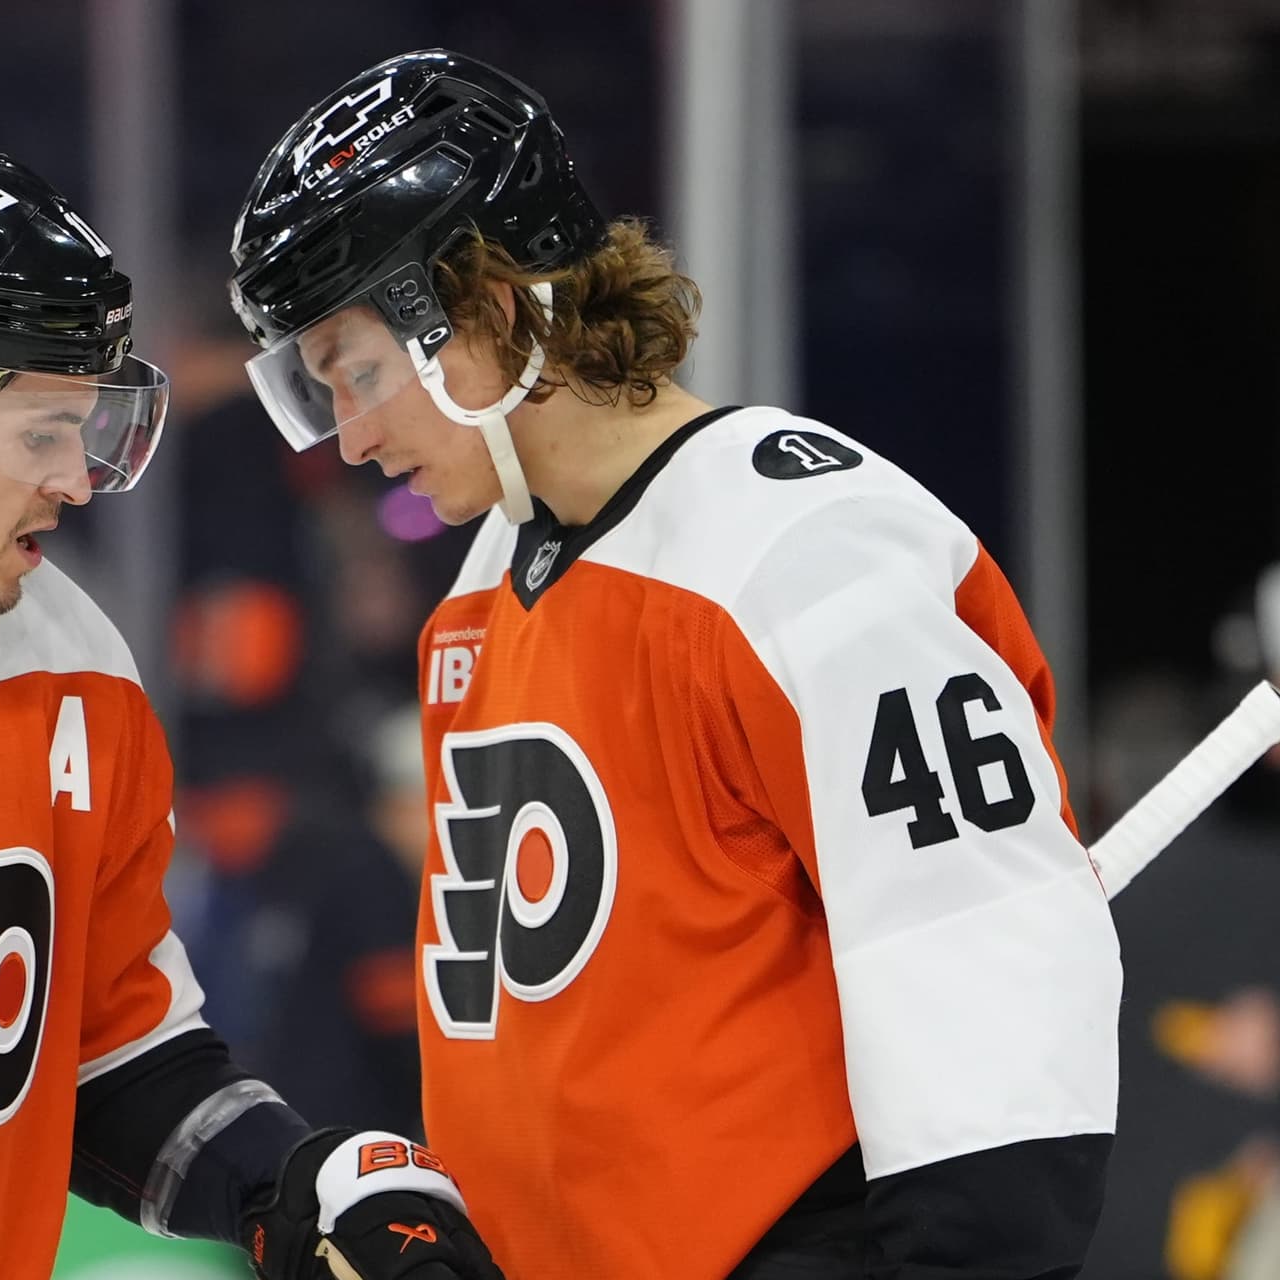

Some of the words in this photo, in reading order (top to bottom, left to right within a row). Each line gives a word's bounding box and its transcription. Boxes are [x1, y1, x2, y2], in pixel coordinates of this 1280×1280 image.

[304, 103, 416, 190] CHEVROLET
[427, 645, 483, 704] IB
[49, 695, 92, 812] A
[860, 672, 1036, 850] 46
